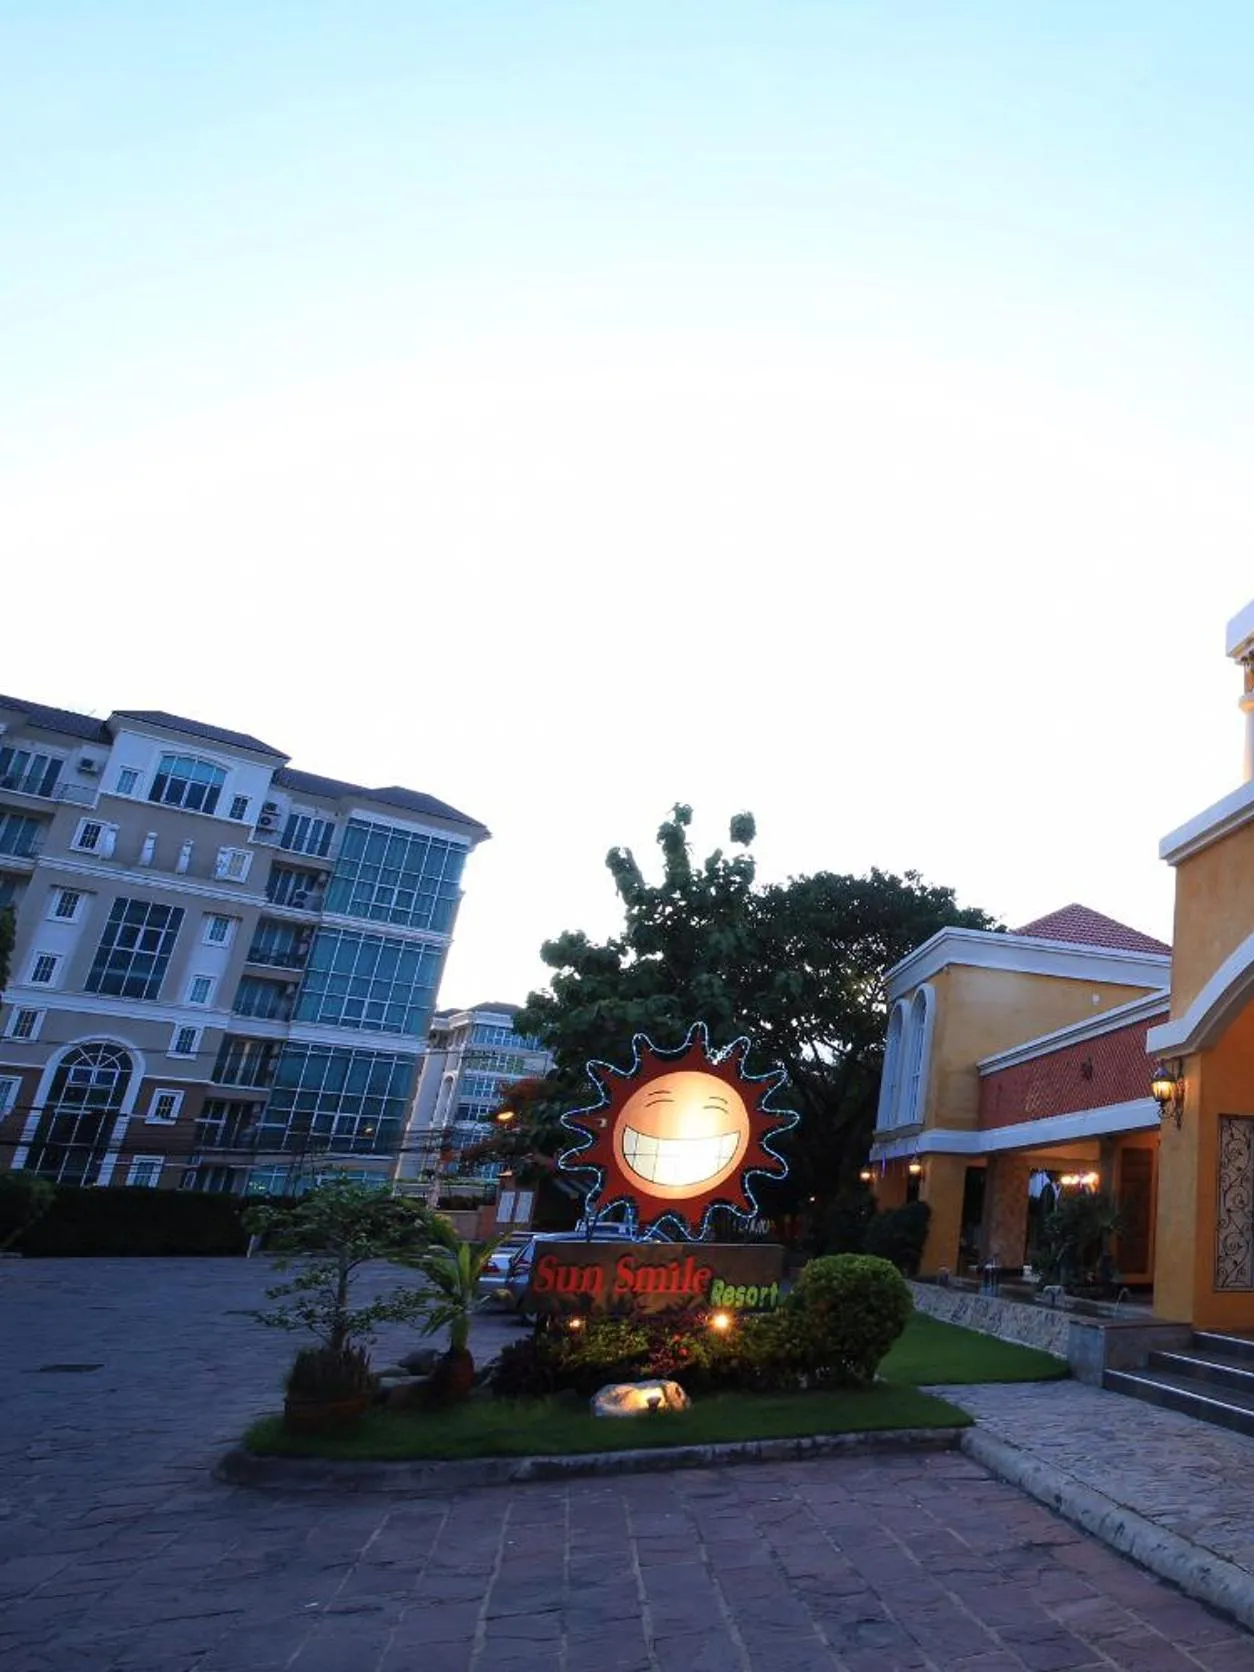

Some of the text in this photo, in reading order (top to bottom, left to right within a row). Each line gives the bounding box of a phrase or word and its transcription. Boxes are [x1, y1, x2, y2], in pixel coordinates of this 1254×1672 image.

[534, 1254, 712, 1297] Sun Smile
[711, 1280, 779, 1308] Resort
